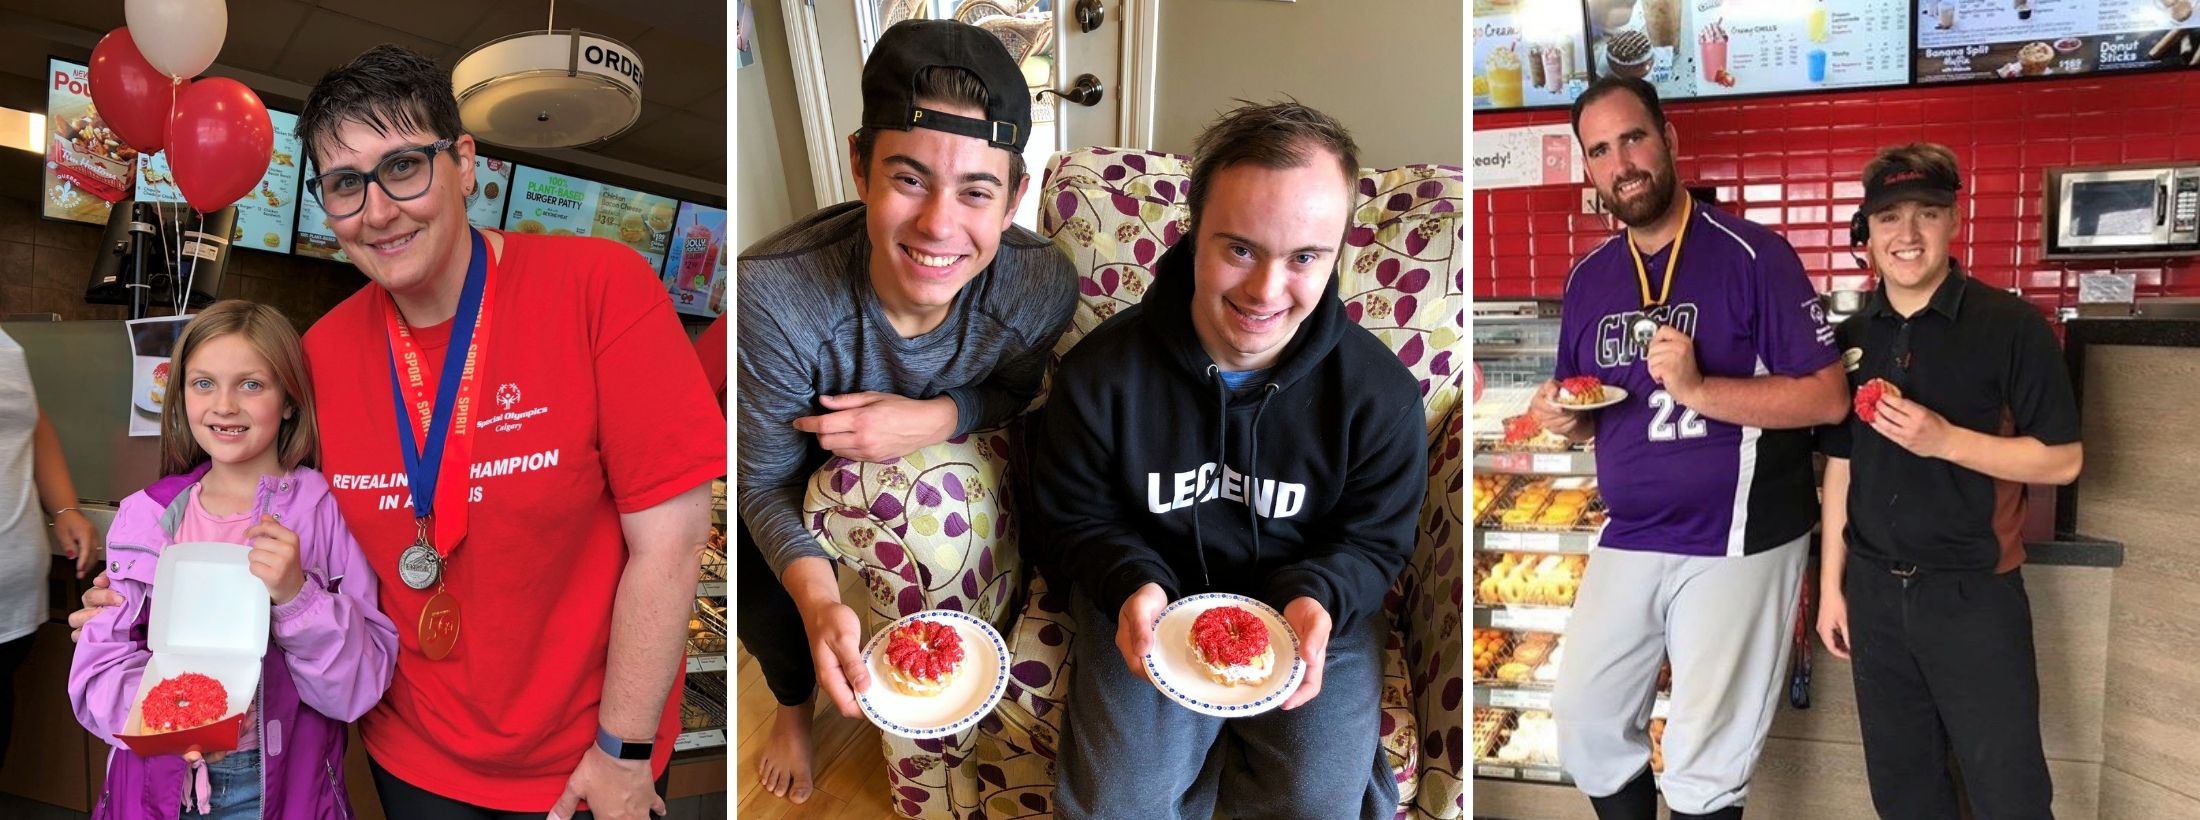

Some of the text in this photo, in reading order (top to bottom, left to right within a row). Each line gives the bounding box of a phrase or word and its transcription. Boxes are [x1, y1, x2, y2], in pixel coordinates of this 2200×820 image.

[1925, 45, 1989, 58] Banana Split
[2100, 40, 2139, 54] Donut
[2100, 51, 2137, 63] Sticks
[54, 70, 91, 98] Pou
[913, 110, 923, 122] P
[1473, 152, 1511, 168] eady!
[528, 181, 585, 201] PLANT-BASED
[549, 176, 568, 188] 100%
[526, 191, 582, 211] BURGER PATTY
[404, 351, 432, 437] SPORT SPIR
[455, 396, 470, 436] SPIRIT
[476, 407, 548, 428] Special Olympics
[1648, 389, 1707, 442] 22
[495, 423, 522, 432] Calgary
[333, 449, 560, 490] REVEALIN HAMPION
[1148, 462, 1306, 519] LEGEND
[379, 495, 400, 510] IN
